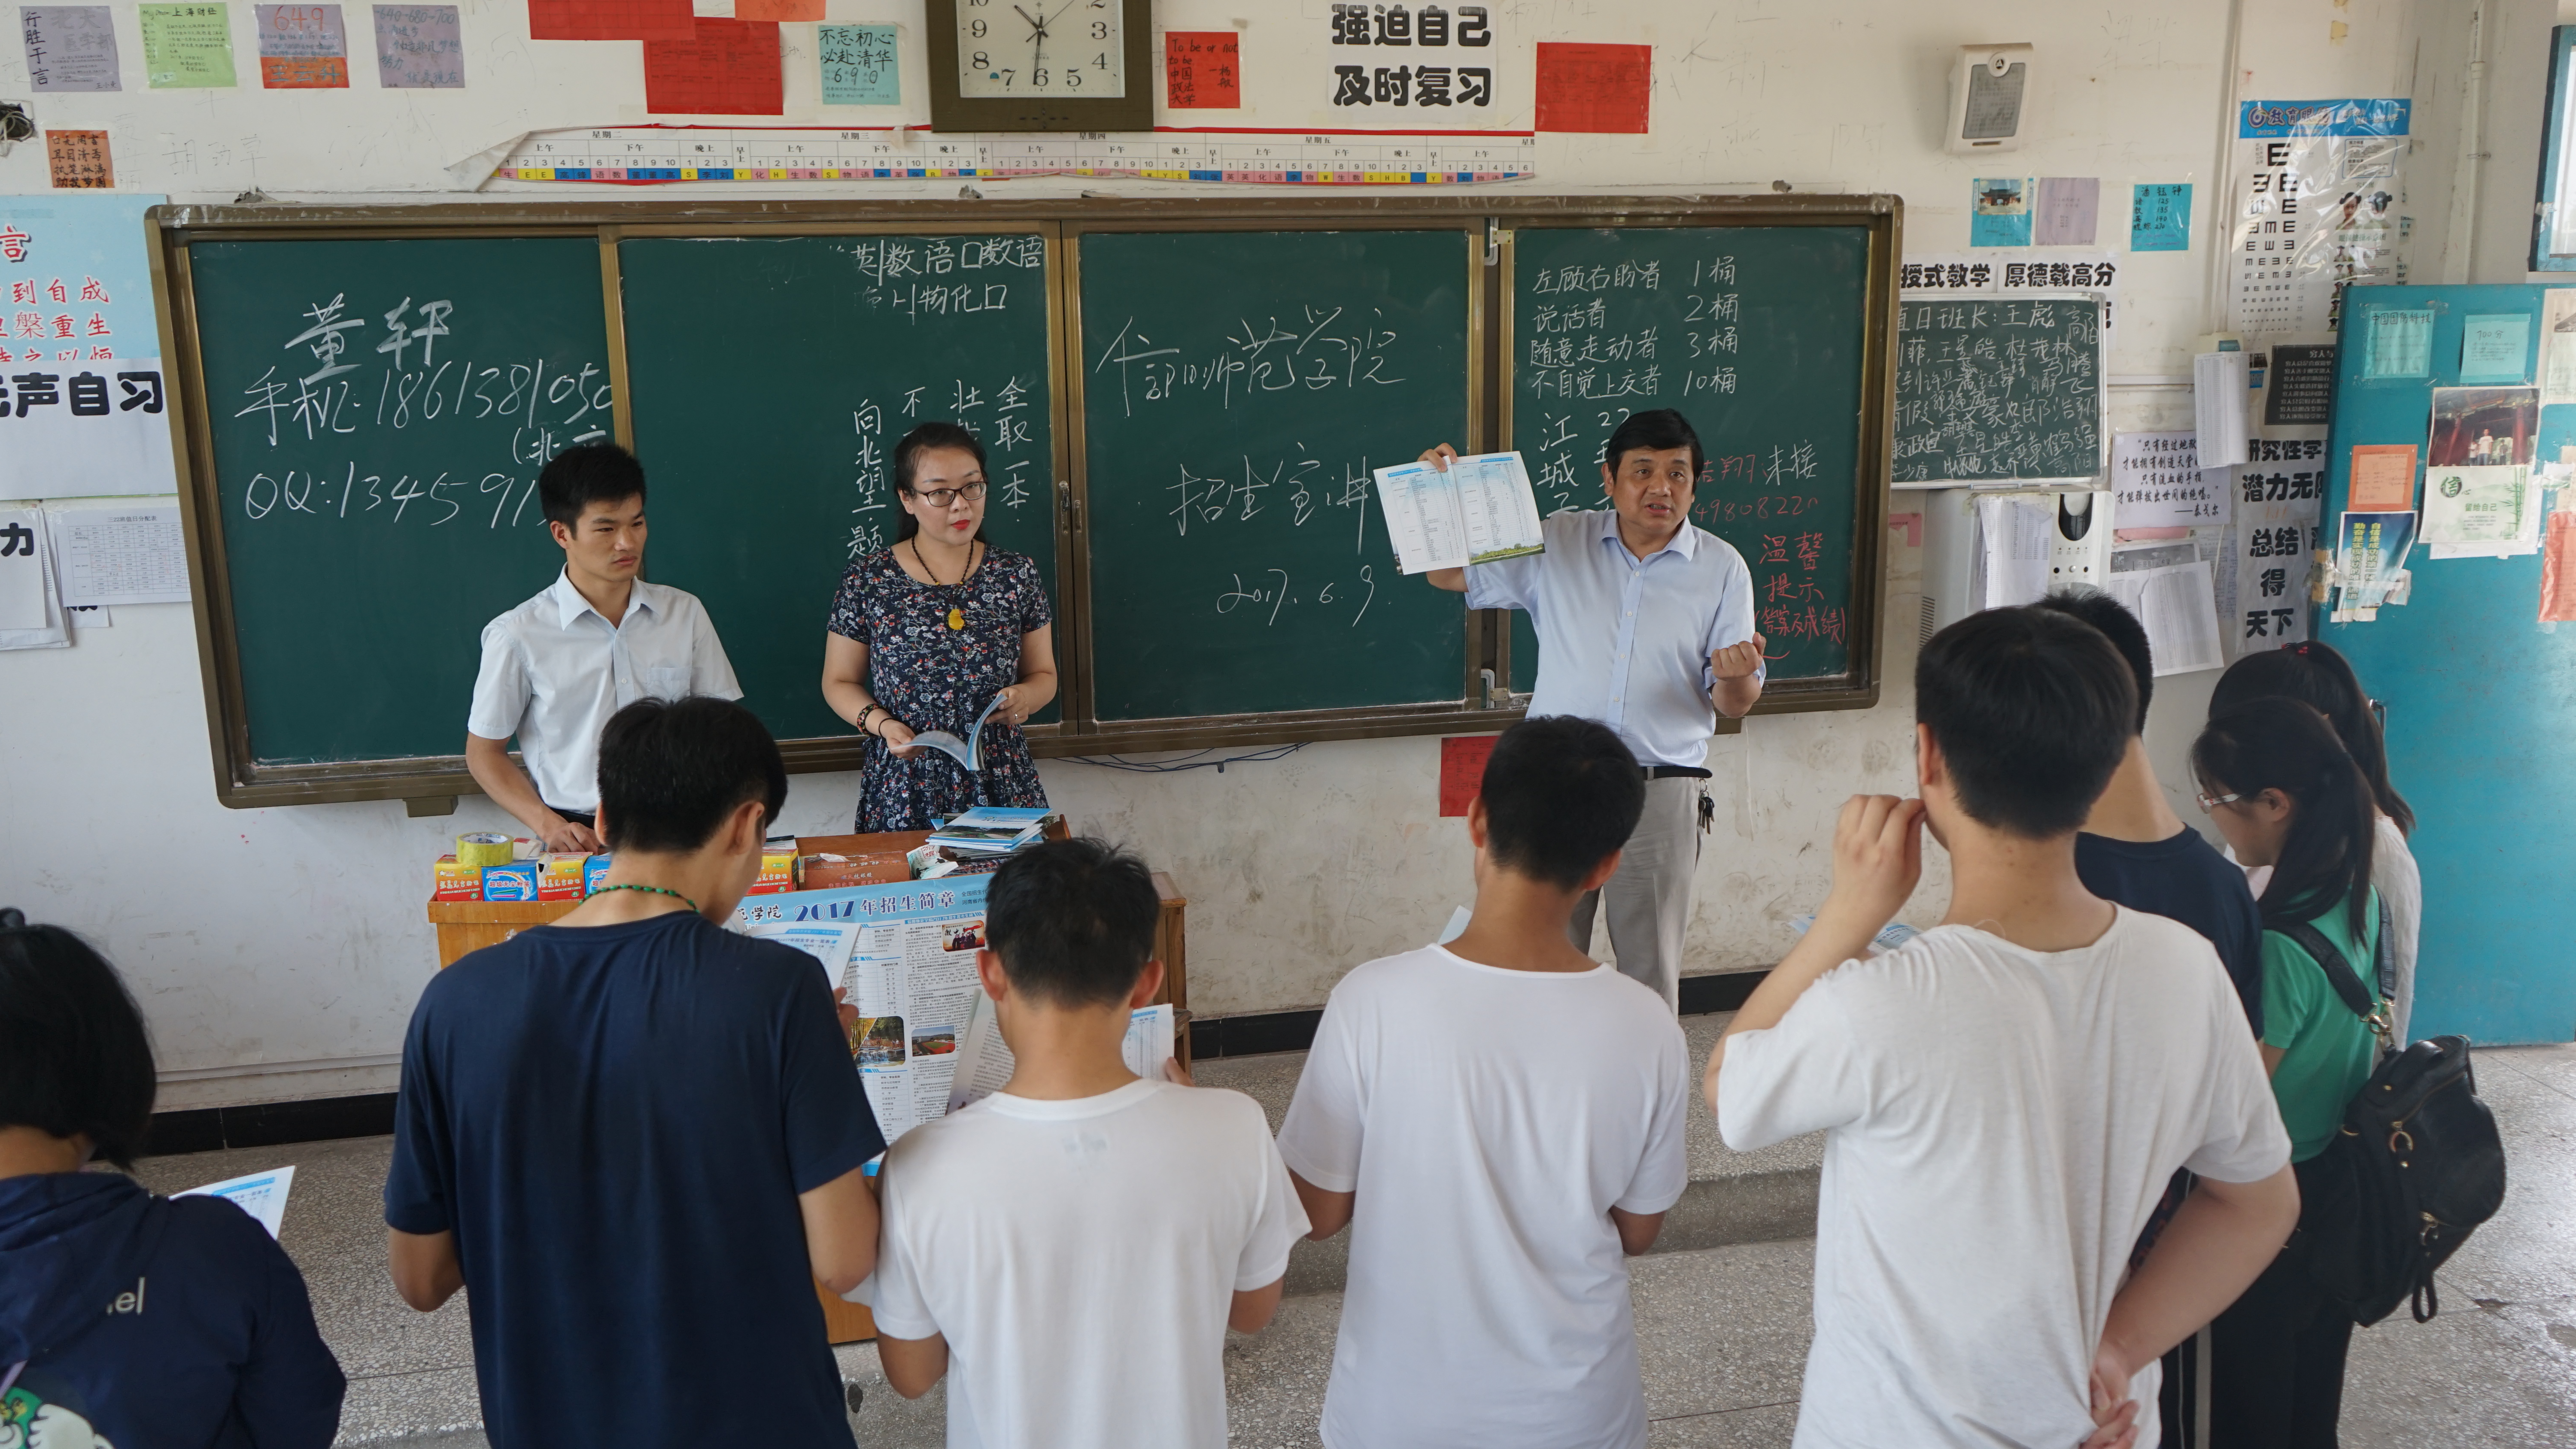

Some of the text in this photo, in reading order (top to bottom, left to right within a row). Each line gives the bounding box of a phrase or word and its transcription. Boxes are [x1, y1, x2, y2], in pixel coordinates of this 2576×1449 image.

[172, 6, 217, 18] 上海财经
[274, 6, 323, 31] 649
[972, 19, 987, 38] 9
[1091, 21, 1107, 39] 3
[1332, 4, 1492, 46] 强迫自己
[24, 11, 49, 85] 行胜于言
[819, 28, 894, 46] 不忘初心
[1172, 38, 1239, 53] To be or not
[820, 48, 893, 72] 必赴清华
[972, 52, 989, 70] 8
[1092, 52, 1108, 70] 4
[1169, 55, 1192, 64] to be
[270, 64, 340, 85] 王云升
[1002, 68, 1016, 86] 7
[1034, 68, 1048, 87] 6
[1066, 68, 1081, 87] 5
[1170, 67, 1192, 83] 中国
[1333, 65, 1492, 107] 及时复习
[1171, 81, 1194, 95] 政法
[1171, 94, 1196, 106] 大学
[592, 130, 1331, 144] 星期二 星期三 星期四 星期五
[535, 144, 554, 152] 上午
[627, 143, 644, 152] 下午
[695, 144, 714, 153] 晚上
[1334, 148, 1350, 156] 下午
[1394, 149, 1411, 158] 晚上
[0, 225, 27, 258] 言
[1532, 259, 1660, 294] 左顾右盼者
[1901, 262, 2117, 288] 授式教学 厚德载高分
[0, 276, 110, 304] 到自成
[1531, 297, 1606, 333] 说话者
[284, 293, 453, 385] 董轩
[1530, 325, 1659, 368] 随意走动者
[0, 371, 163, 418] 声自习
[2249, 439, 2327, 462] 研究性学
[245, 461, 547, 529] QQ:134591
[2465, 503, 2497, 512] 留给自己
[0, 522, 34, 557] 力
[2249, 526, 2299, 558] 总结
[2364, 522, 2382, 586] 自信是成功的第一秘
[1763, 573, 1825, 602] 提示
[2260, 568, 2285, 597] 得
[2246, 608, 2294, 638] 天下
[793, 901, 855, 922] 2017
